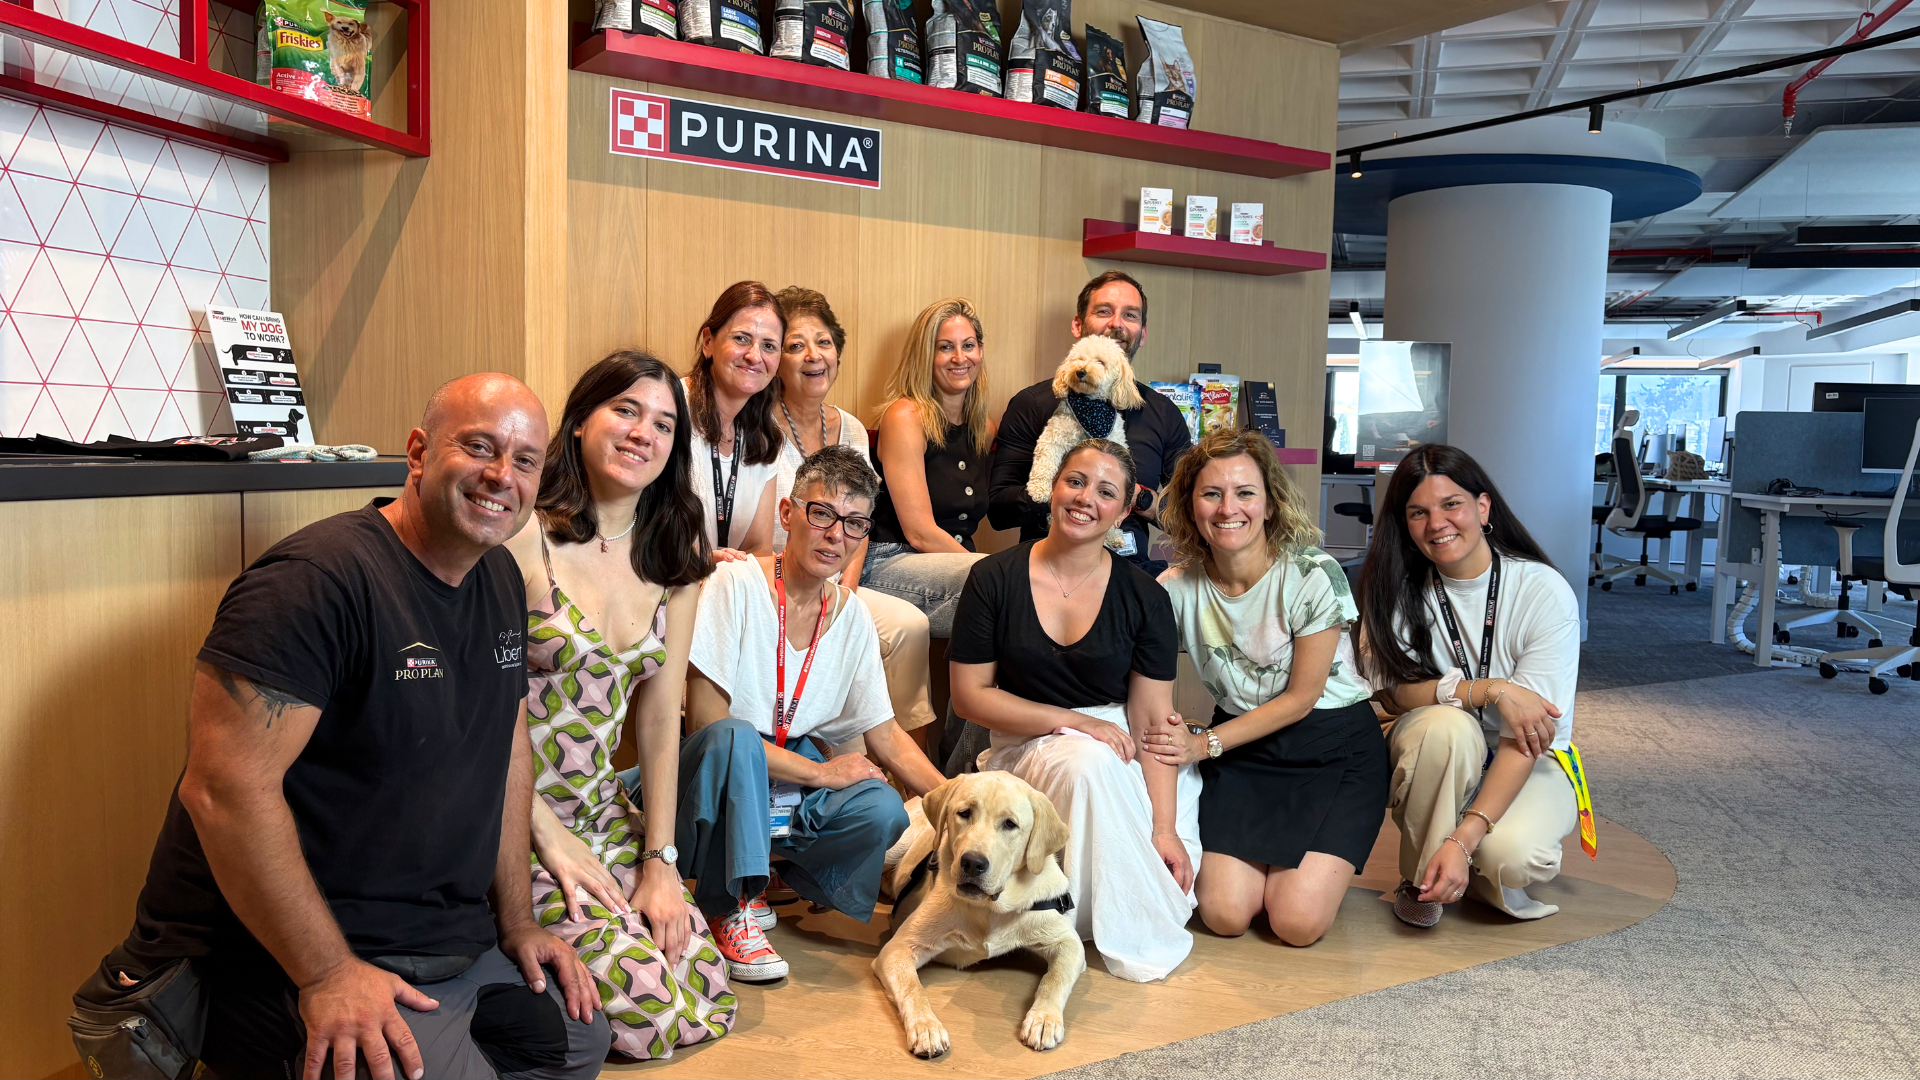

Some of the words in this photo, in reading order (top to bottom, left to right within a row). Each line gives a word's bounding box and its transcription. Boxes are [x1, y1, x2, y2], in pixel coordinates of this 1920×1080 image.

[821, 13, 835, 27] PRO
[280, 31, 321, 48] Friskies
[973, 42, 986, 53] PRO
[1053, 58, 1066, 70] PRO
[241, 320, 257, 331] MY
[260, 322, 283, 334] DOG
[244, 332, 256, 340] TO
[257, 333, 285, 344] WORK?
[395, 669, 419, 680] PRO
[421, 668, 444, 678] PLAN
[785, 698, 799, 725] PURINA
